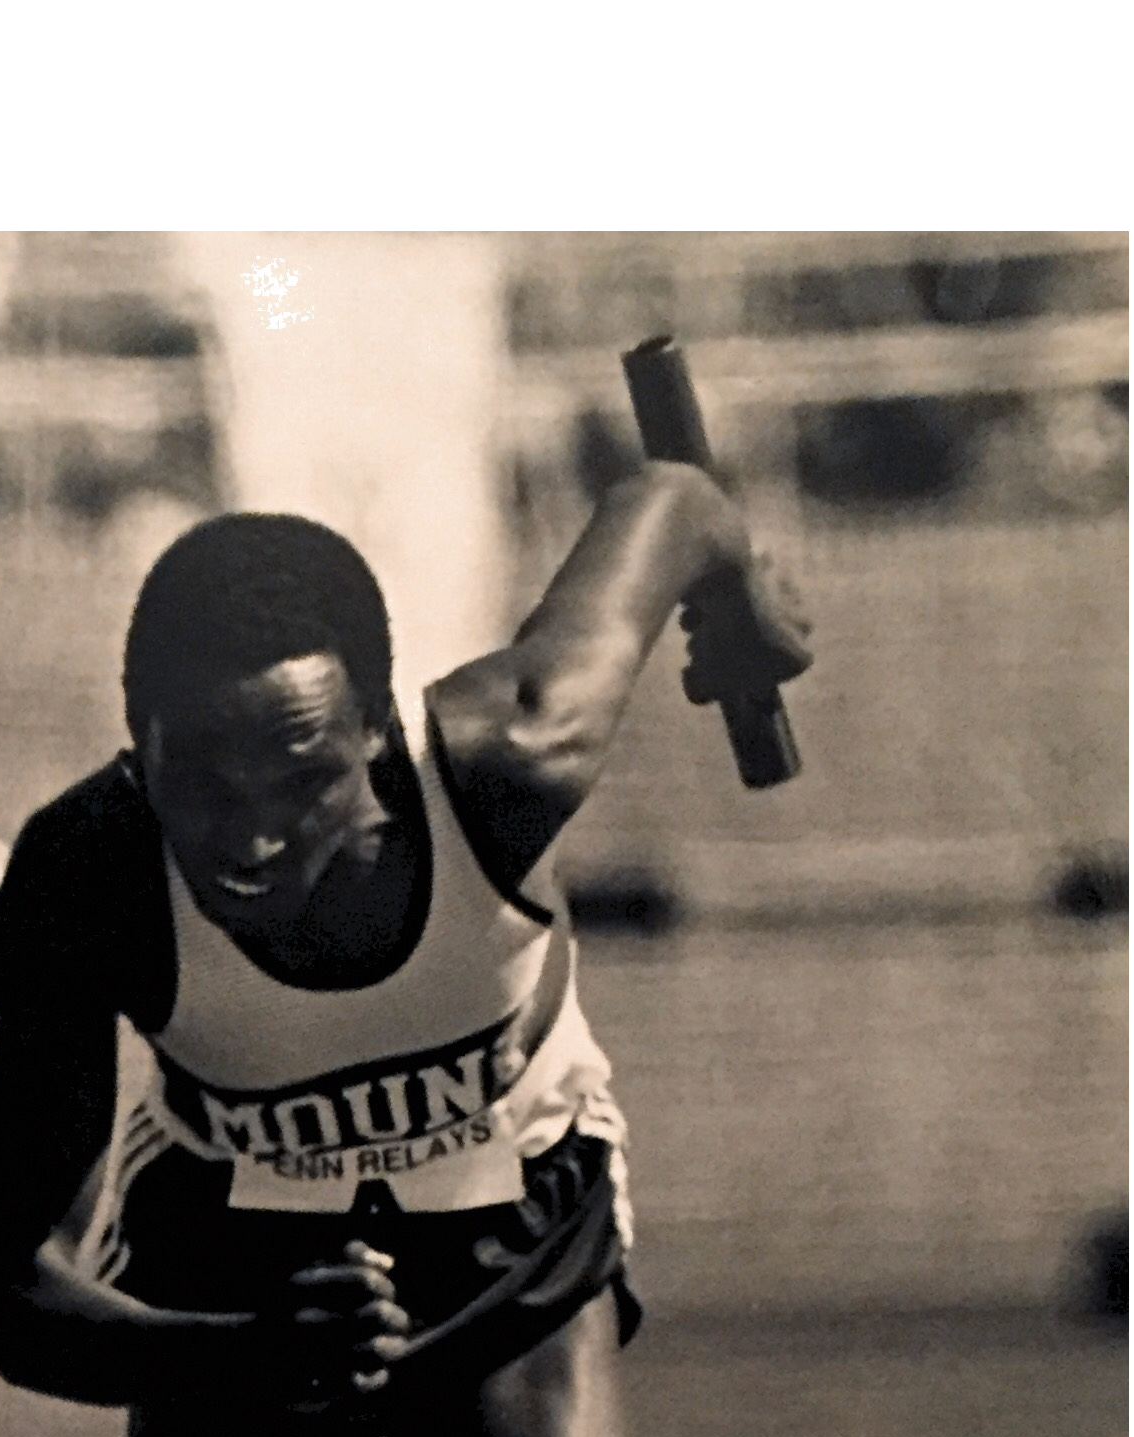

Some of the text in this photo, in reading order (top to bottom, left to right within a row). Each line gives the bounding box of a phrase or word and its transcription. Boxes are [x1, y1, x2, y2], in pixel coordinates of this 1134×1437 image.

[198, 1046, 506, 1153] MOUN
[254, 1114, 491, 1180] ENN RELAYS
